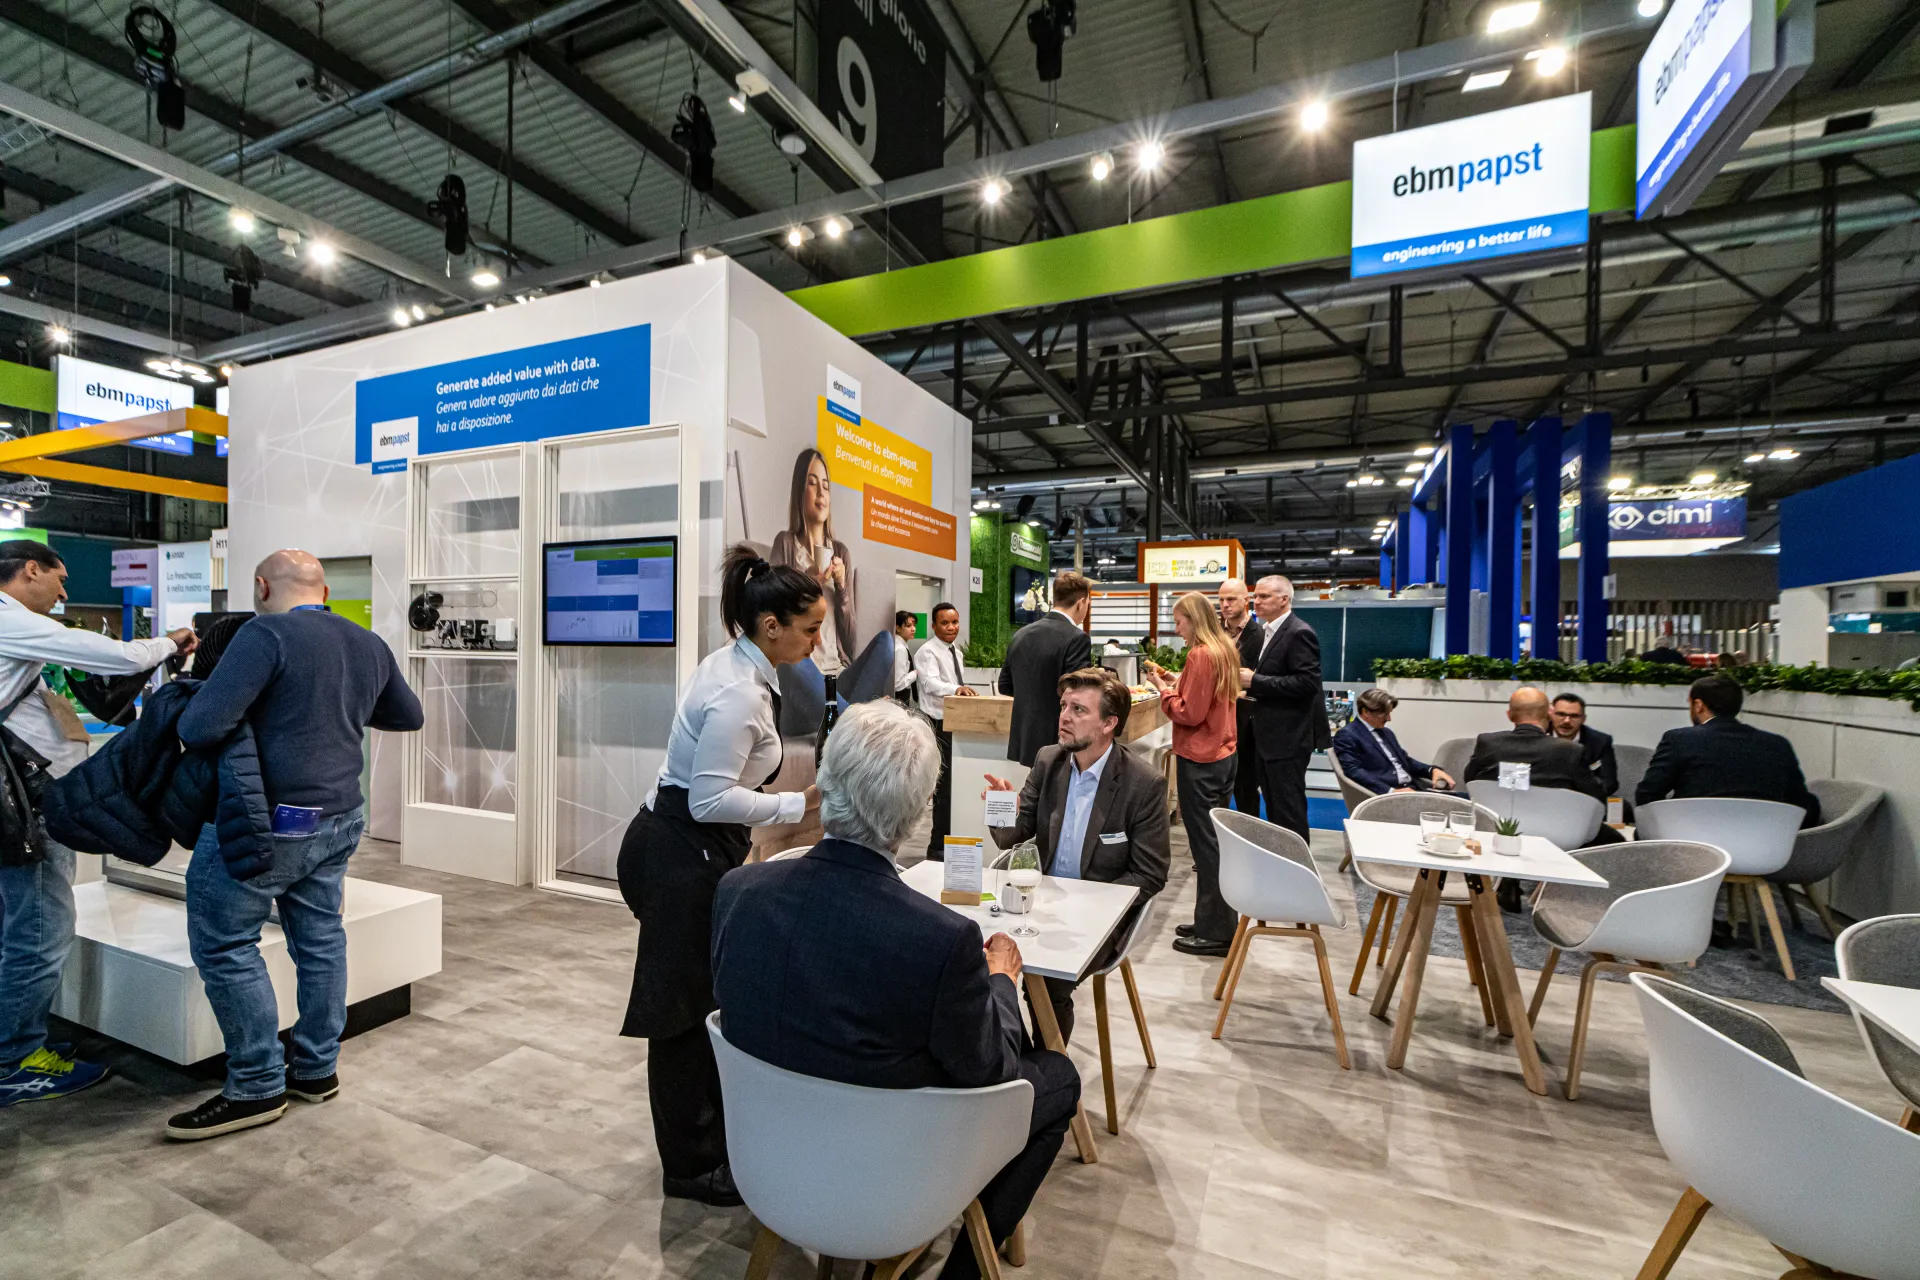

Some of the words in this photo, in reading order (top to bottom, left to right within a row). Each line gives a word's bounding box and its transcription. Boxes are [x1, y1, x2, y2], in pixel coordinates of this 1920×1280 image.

[837, 35, 877, 166] 9
[1393, 142, 1543, 197] ebmpapst
[1383, 239, 1465, 264] engineering
[1467, 238, 1476, 249] a
[1478, 229, 1525, 247] better
[1527, 224, 1552, 240] life
[436, 377, 479, 395] Generate
[481, 369, 512, 388] added
[514, 366, 542, 381] value
[544, 360, 568, 376] with
[571, 356, 600, 372] data.
[833, 380, 856, 400] ebmpapst
[86, 381, 171, 412] ebmpapst
[436, 401, 467, 414] Genera
[469, 394, 496, 409] valore
[498, 387, 540, 408] aggiunto
[542, 383, 558, 398] dai
[559, 379, 580, 395] dati
[581, 376, 599, 392] che
[436, 420, 450, 433] hai
[451, 422, 457, 431] a
[458, 413, 514, 432] disposizione.
[379, 432, 410, 447] ebmpapst
[836, 422, 872, 451] Welcome
[873, 441, 881, 455] to
[882, 445, 919, 472] ebm-papst.
[835, 445, 872, 471] Benvenuti
[873, 463, 880, 474] in
[875, 498, 887, 508] world
[1648, 503, 1713, 525] cimi
